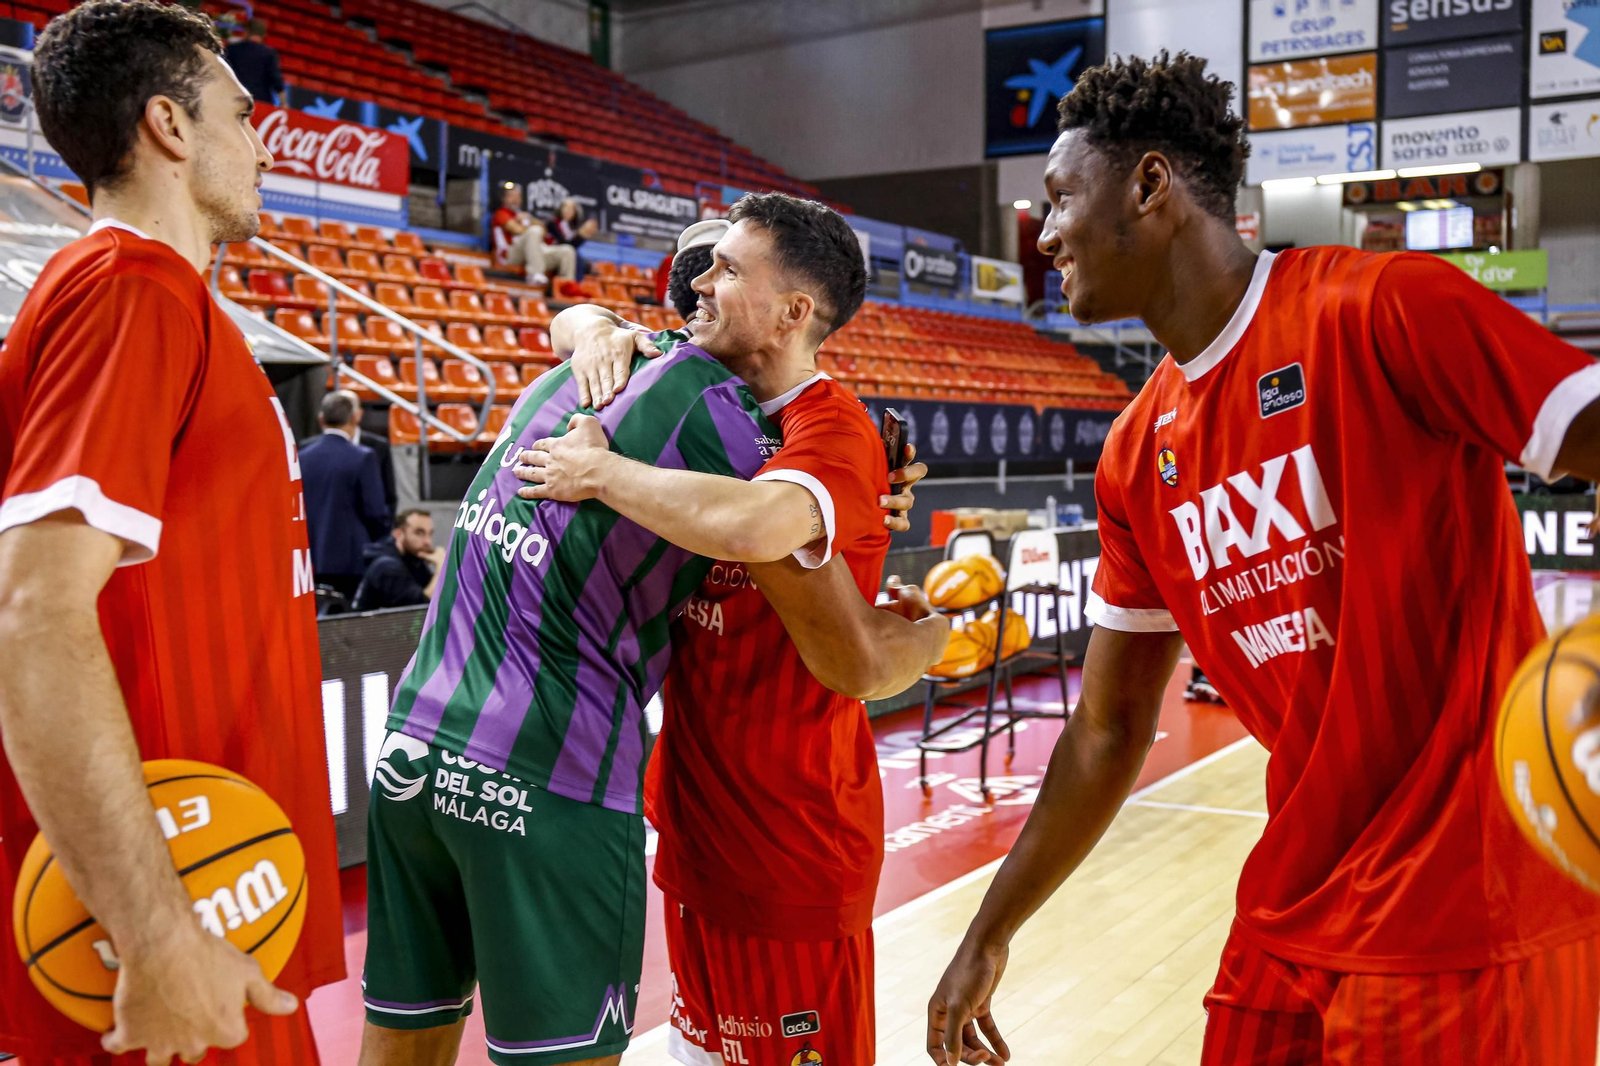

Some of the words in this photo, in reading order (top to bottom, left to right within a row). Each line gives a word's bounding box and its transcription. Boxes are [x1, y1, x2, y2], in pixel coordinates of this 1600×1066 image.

[257, 110, 387, 187] Coca-Cola
[1263, 389, 1303, 412] endesa
[1168, 443, 1338, 582] BAXI
[684, 599, 724, 636] ESA
[435, 767, 475, 798] DEL
[479, 780, 533, 813] SOL
[434, 792, 526, 837] MÁLAGA
[786, 1020, 812, 1035] acb
[721, 1036, 750, 1065] ETL
